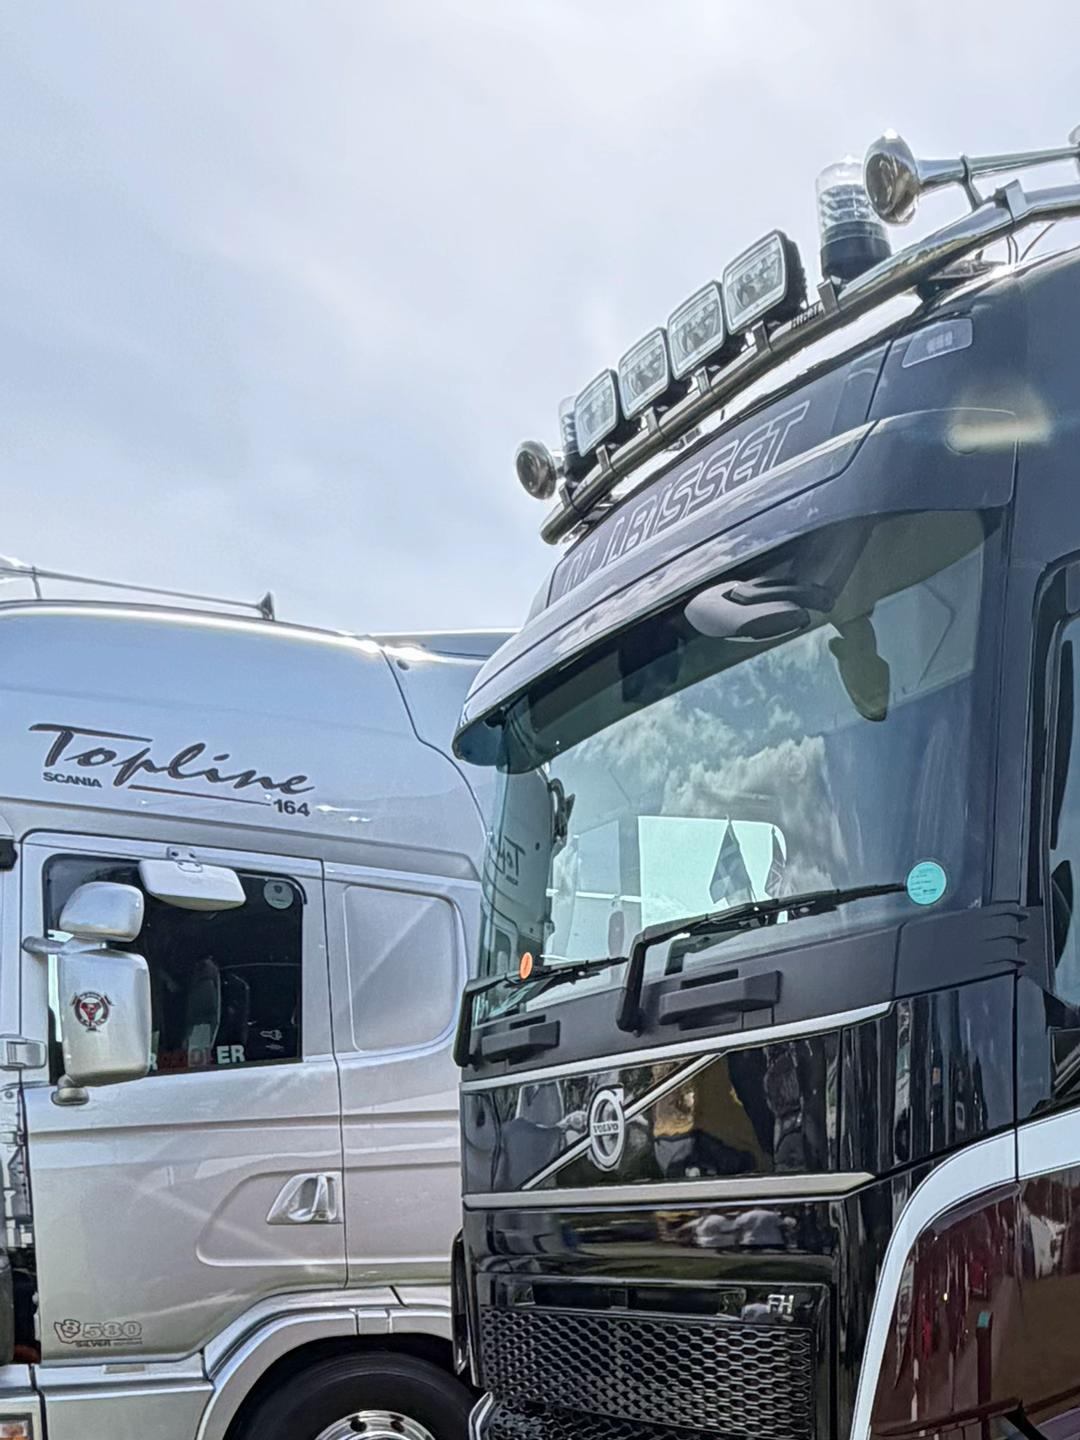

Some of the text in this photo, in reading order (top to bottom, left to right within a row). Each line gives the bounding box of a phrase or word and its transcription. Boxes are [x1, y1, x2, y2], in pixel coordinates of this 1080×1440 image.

[618, 400, 810, 549] BISSET
[28, 723, 315, 795] Topline
[42, 771, 103, 789] SCANIA
[273, 799, 311, 817] 164
[767, 1293, 795, 1315] FH
